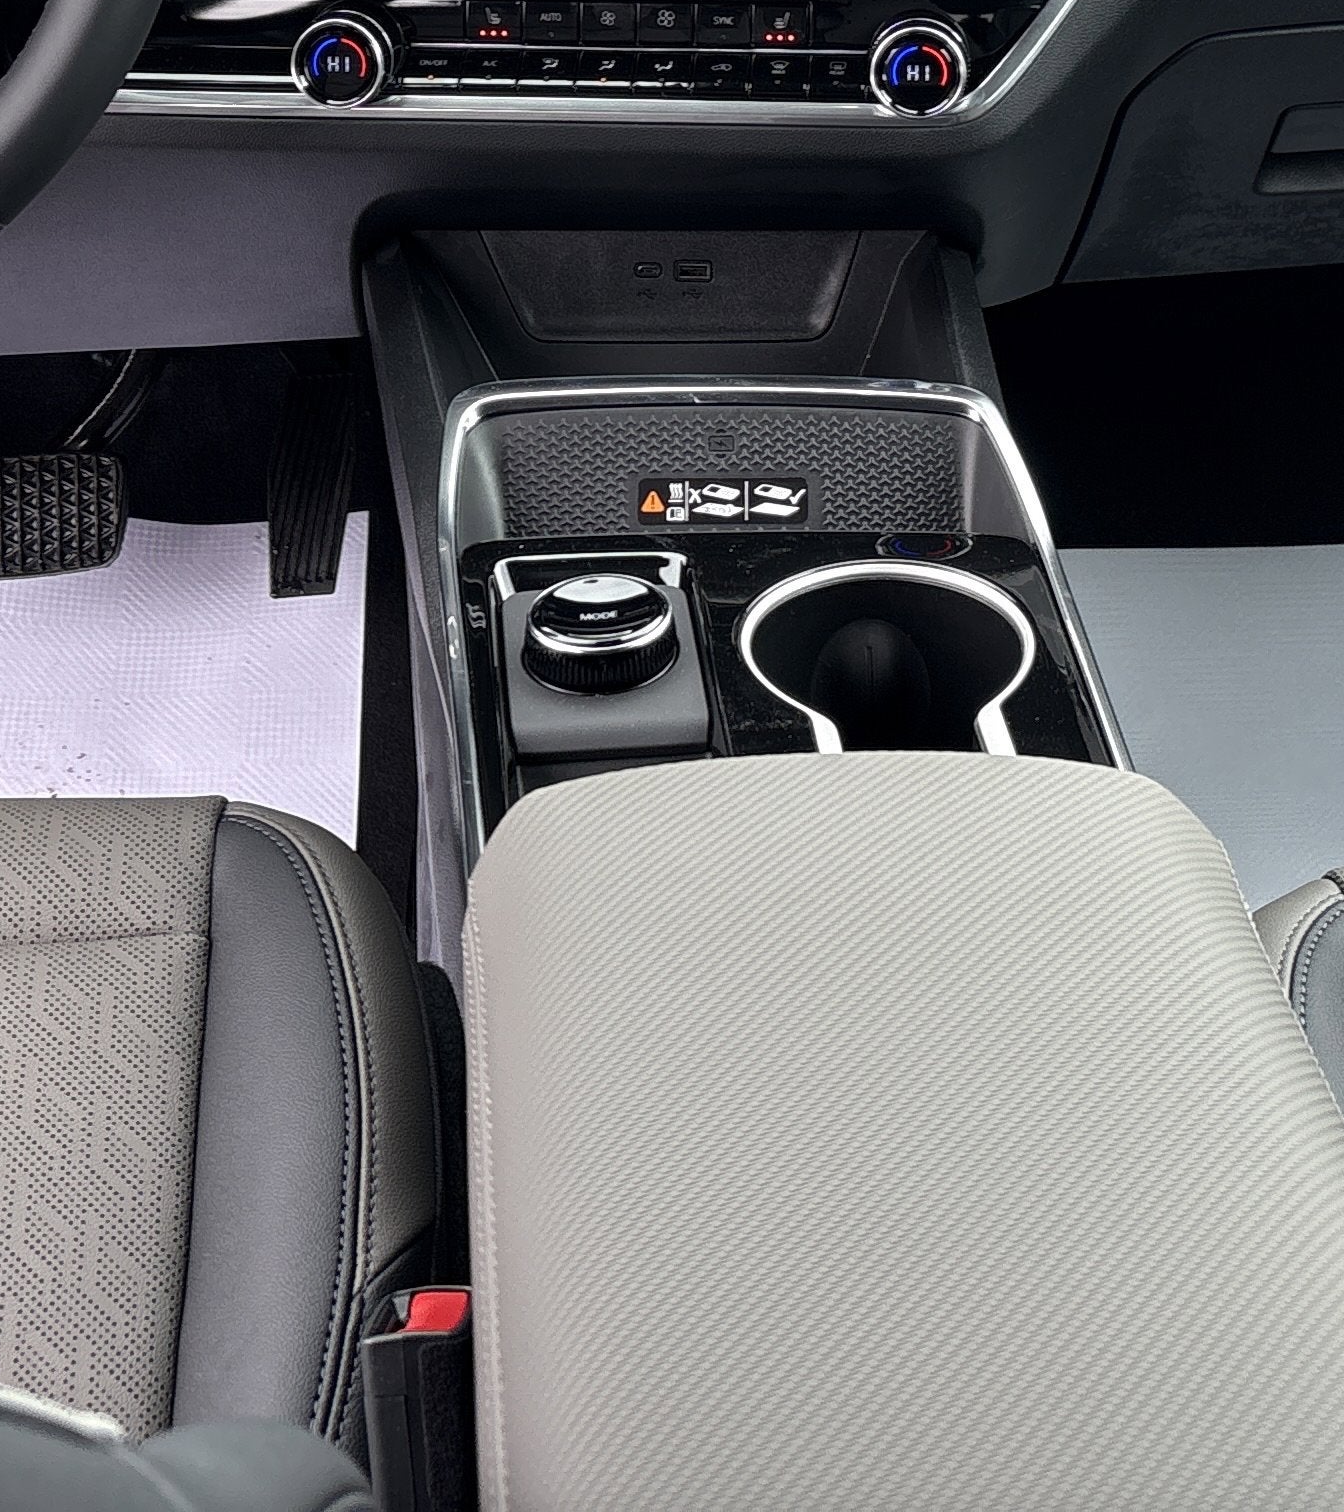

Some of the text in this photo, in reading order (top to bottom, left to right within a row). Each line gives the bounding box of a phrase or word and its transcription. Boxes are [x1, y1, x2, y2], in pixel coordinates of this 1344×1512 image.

[539, 12, 562, 23] AUTO
[712, 15, 735, 27] SYNC
[326, 55, 350, 73] HI
[906, 64, 931, 82] HI
